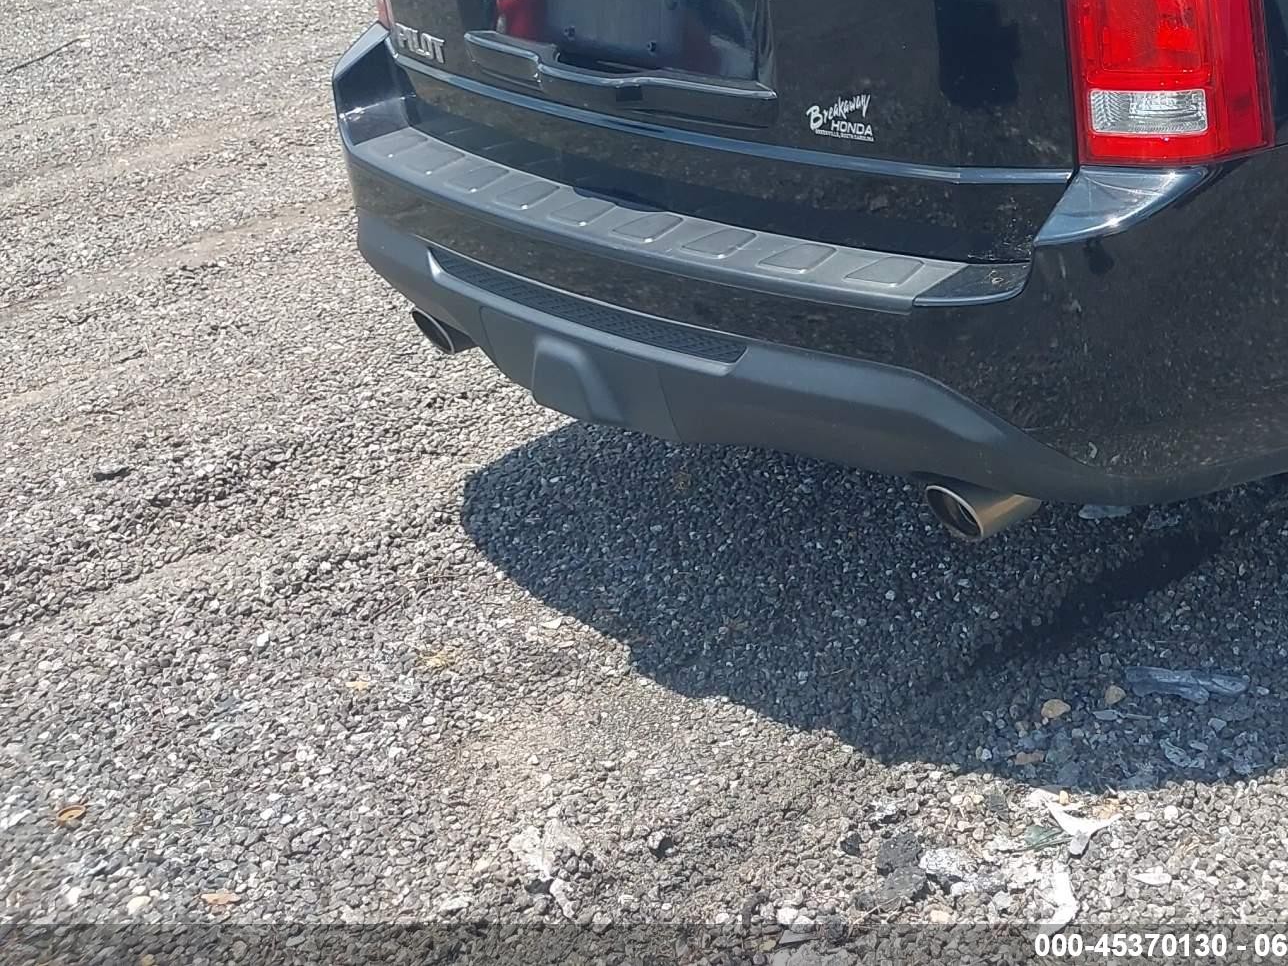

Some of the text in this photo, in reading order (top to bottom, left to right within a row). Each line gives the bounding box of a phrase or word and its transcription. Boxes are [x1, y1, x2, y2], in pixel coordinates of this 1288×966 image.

[396, 22, 445, 64] PILOT
[806, 94, 871, 131] Breakaway
[831, 120, 873, 136] HONDA
